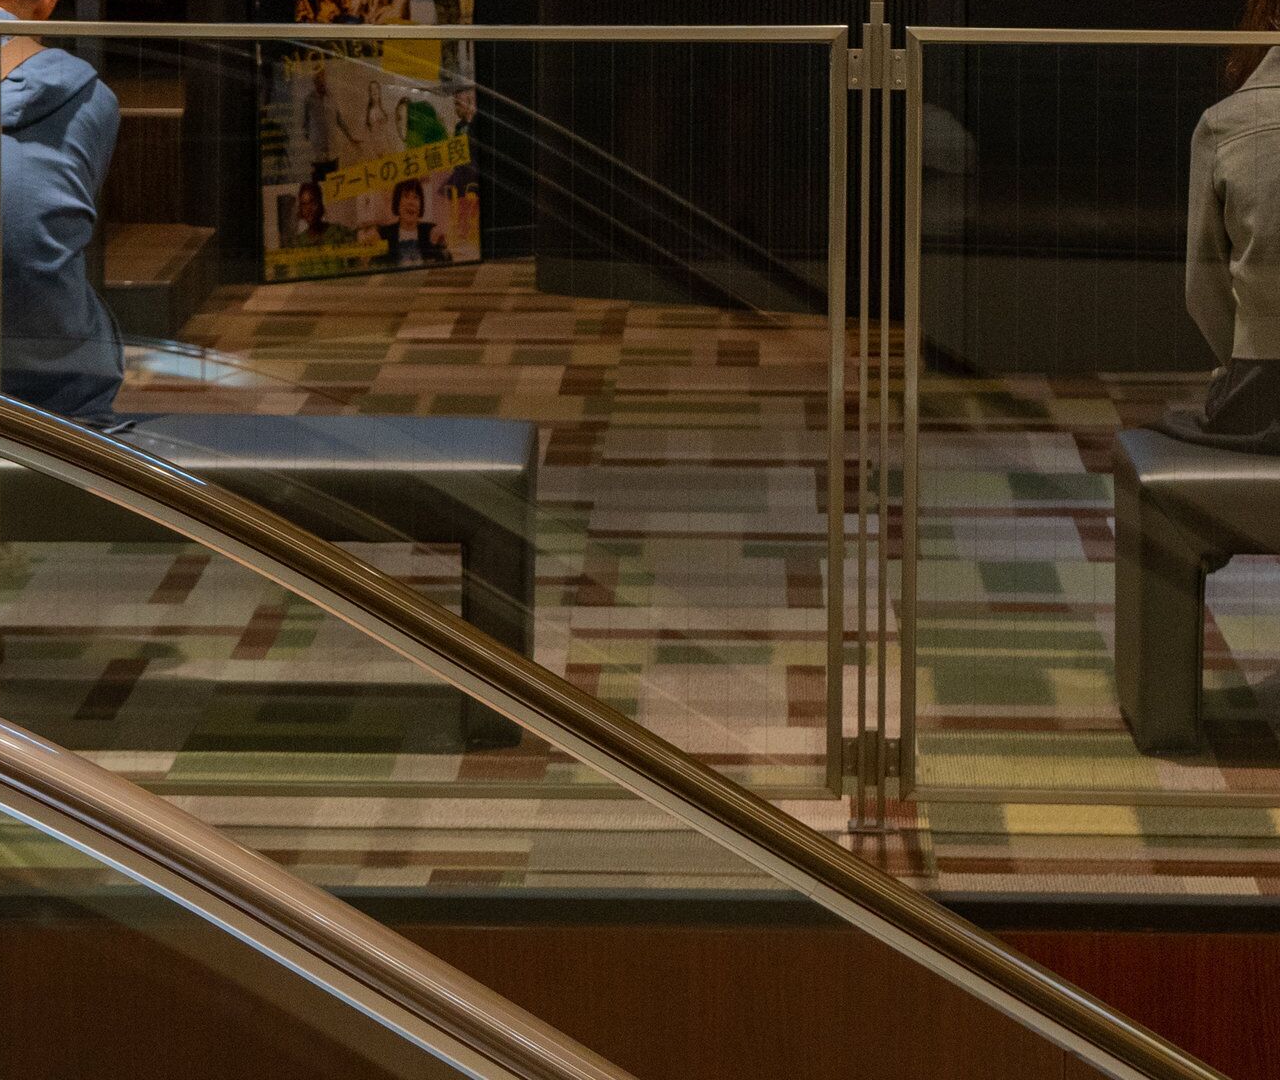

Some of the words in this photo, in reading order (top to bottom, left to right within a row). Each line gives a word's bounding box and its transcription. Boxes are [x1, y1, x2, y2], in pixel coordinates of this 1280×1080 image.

[330, 137, 467, 198] アートのお値段
